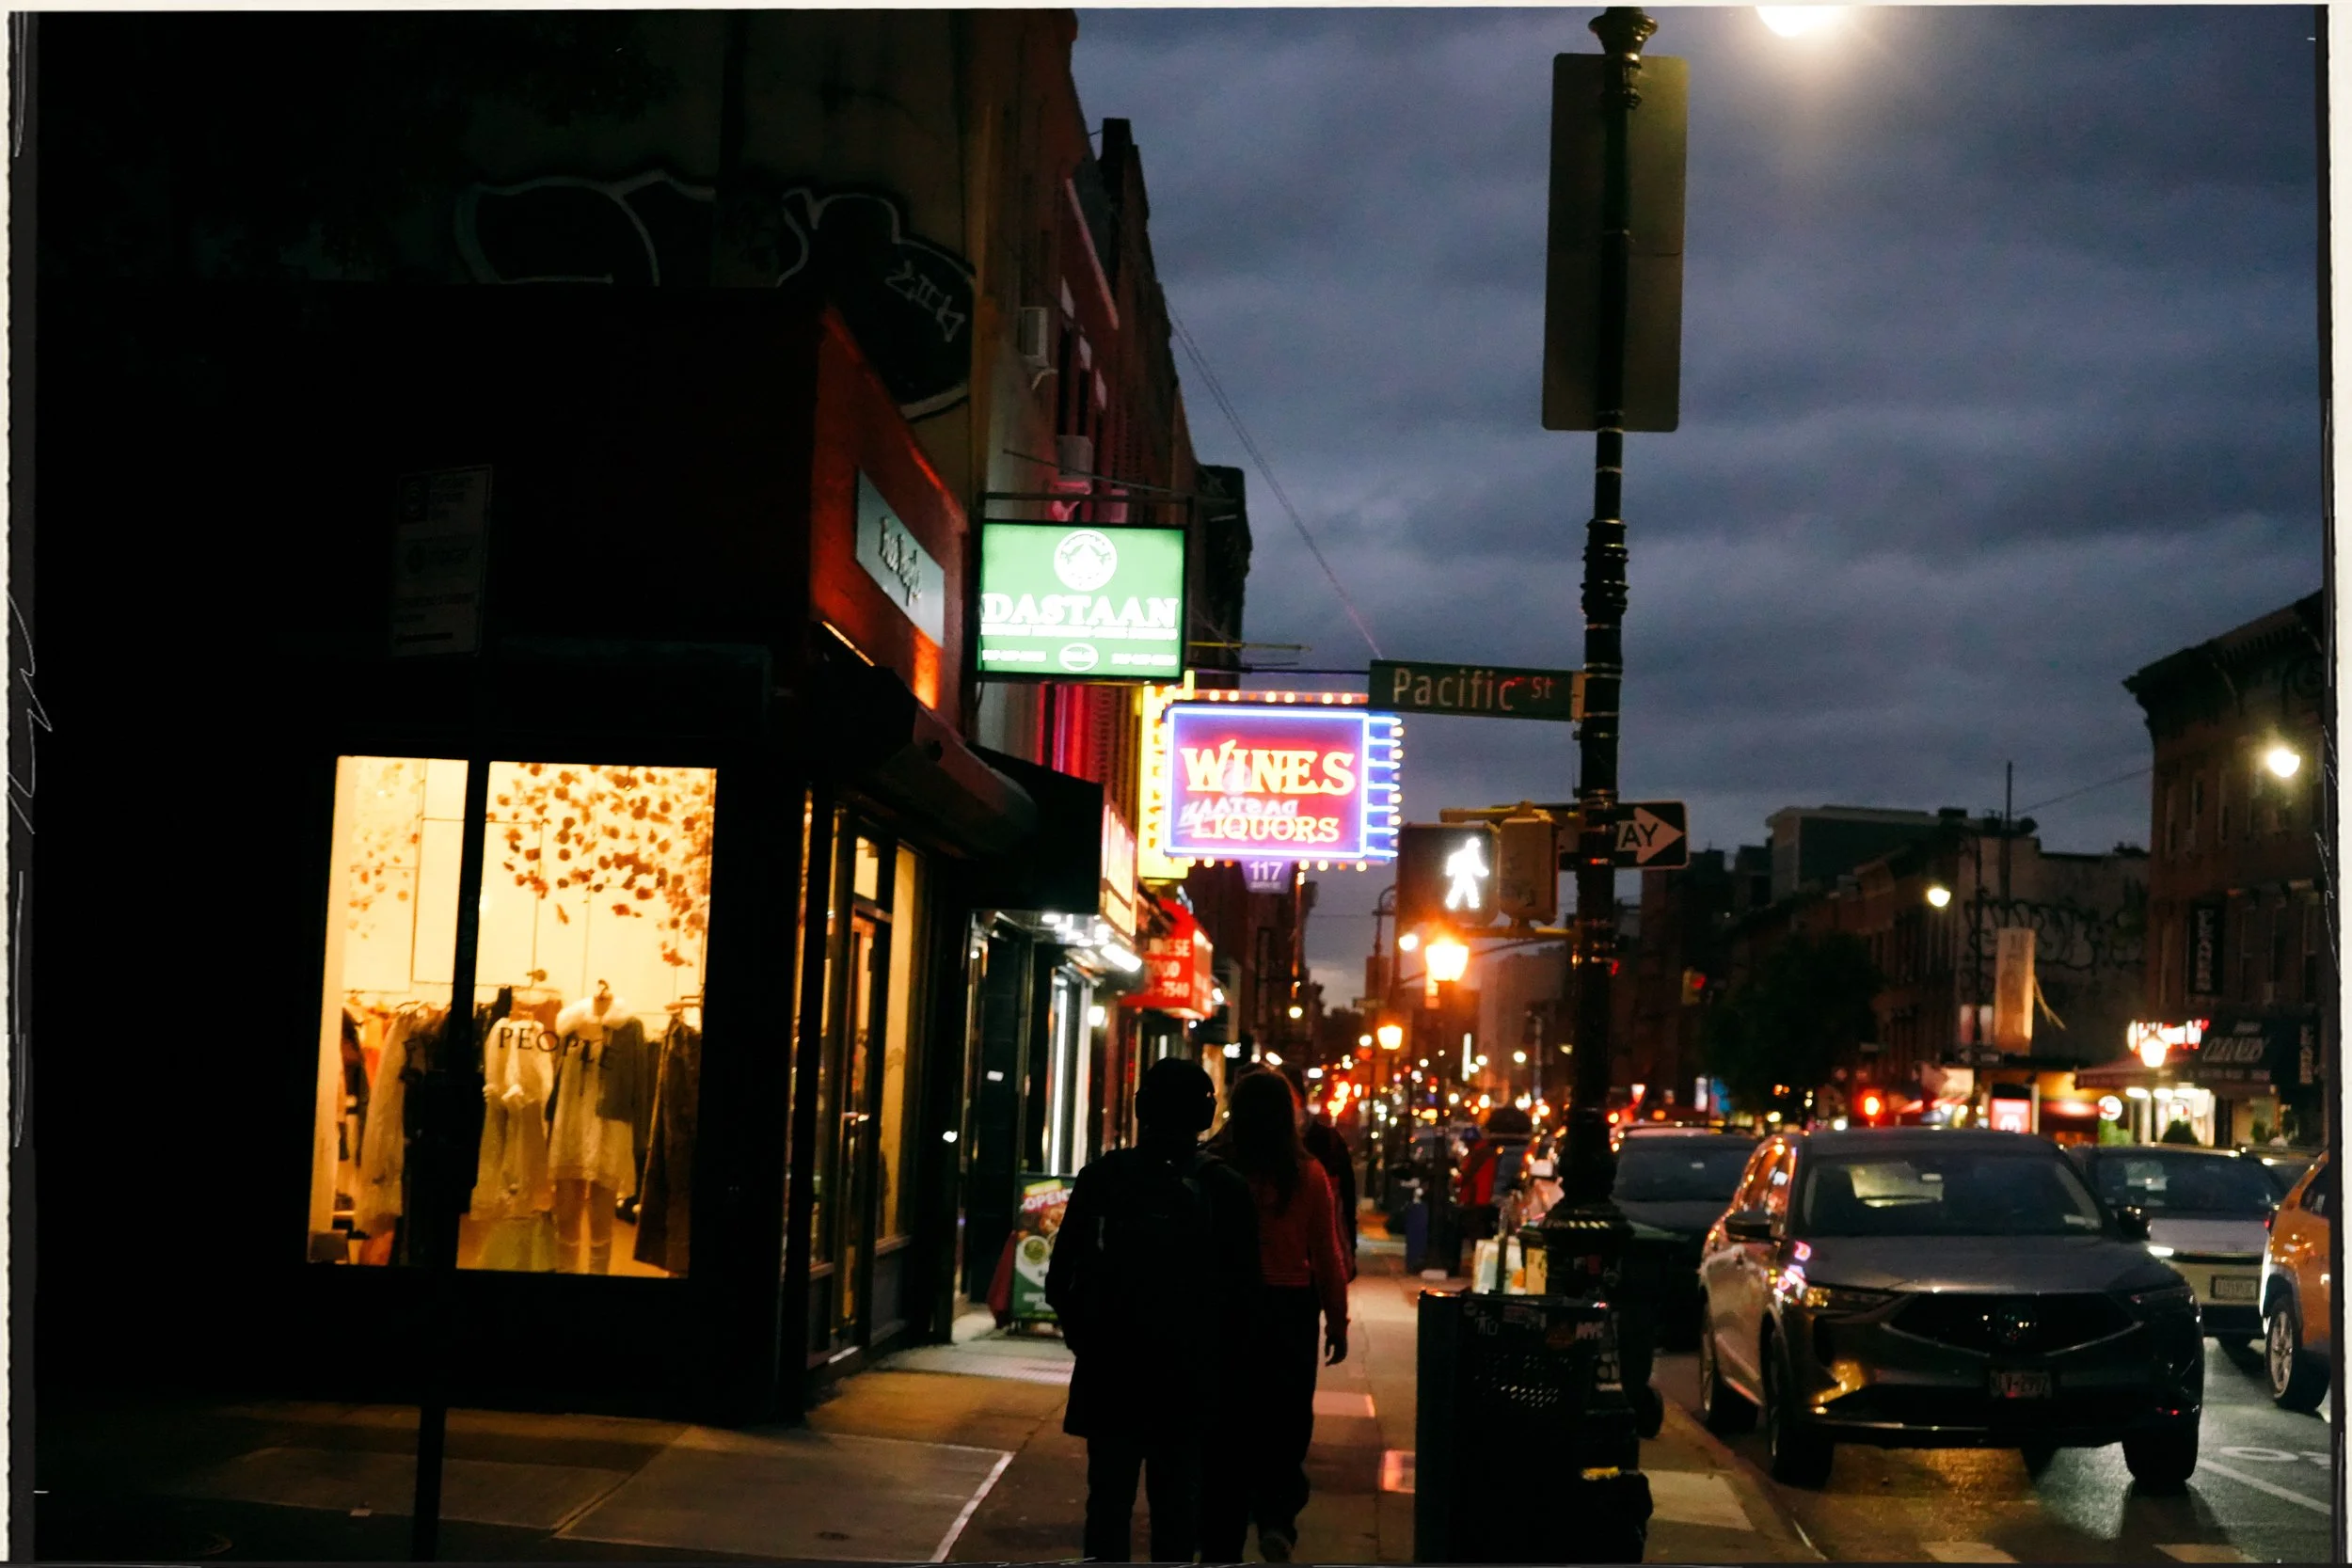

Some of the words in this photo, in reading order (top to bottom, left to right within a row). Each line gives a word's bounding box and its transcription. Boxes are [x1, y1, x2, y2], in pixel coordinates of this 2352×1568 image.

[981, 594, 1179, 628] DASTAAN
[1392, 668, 1517, 711] Pacific
[1531, 676, 1552, 699] St
[1180, 739, 1355, 796] WINES
[1192, 815, 1340, 843] LIQUORS
[1620, 822, 1659, 847] AY
[1249, 861, 1284, 881] 117
[499, 1026, 612, 1070] PEOPLE
